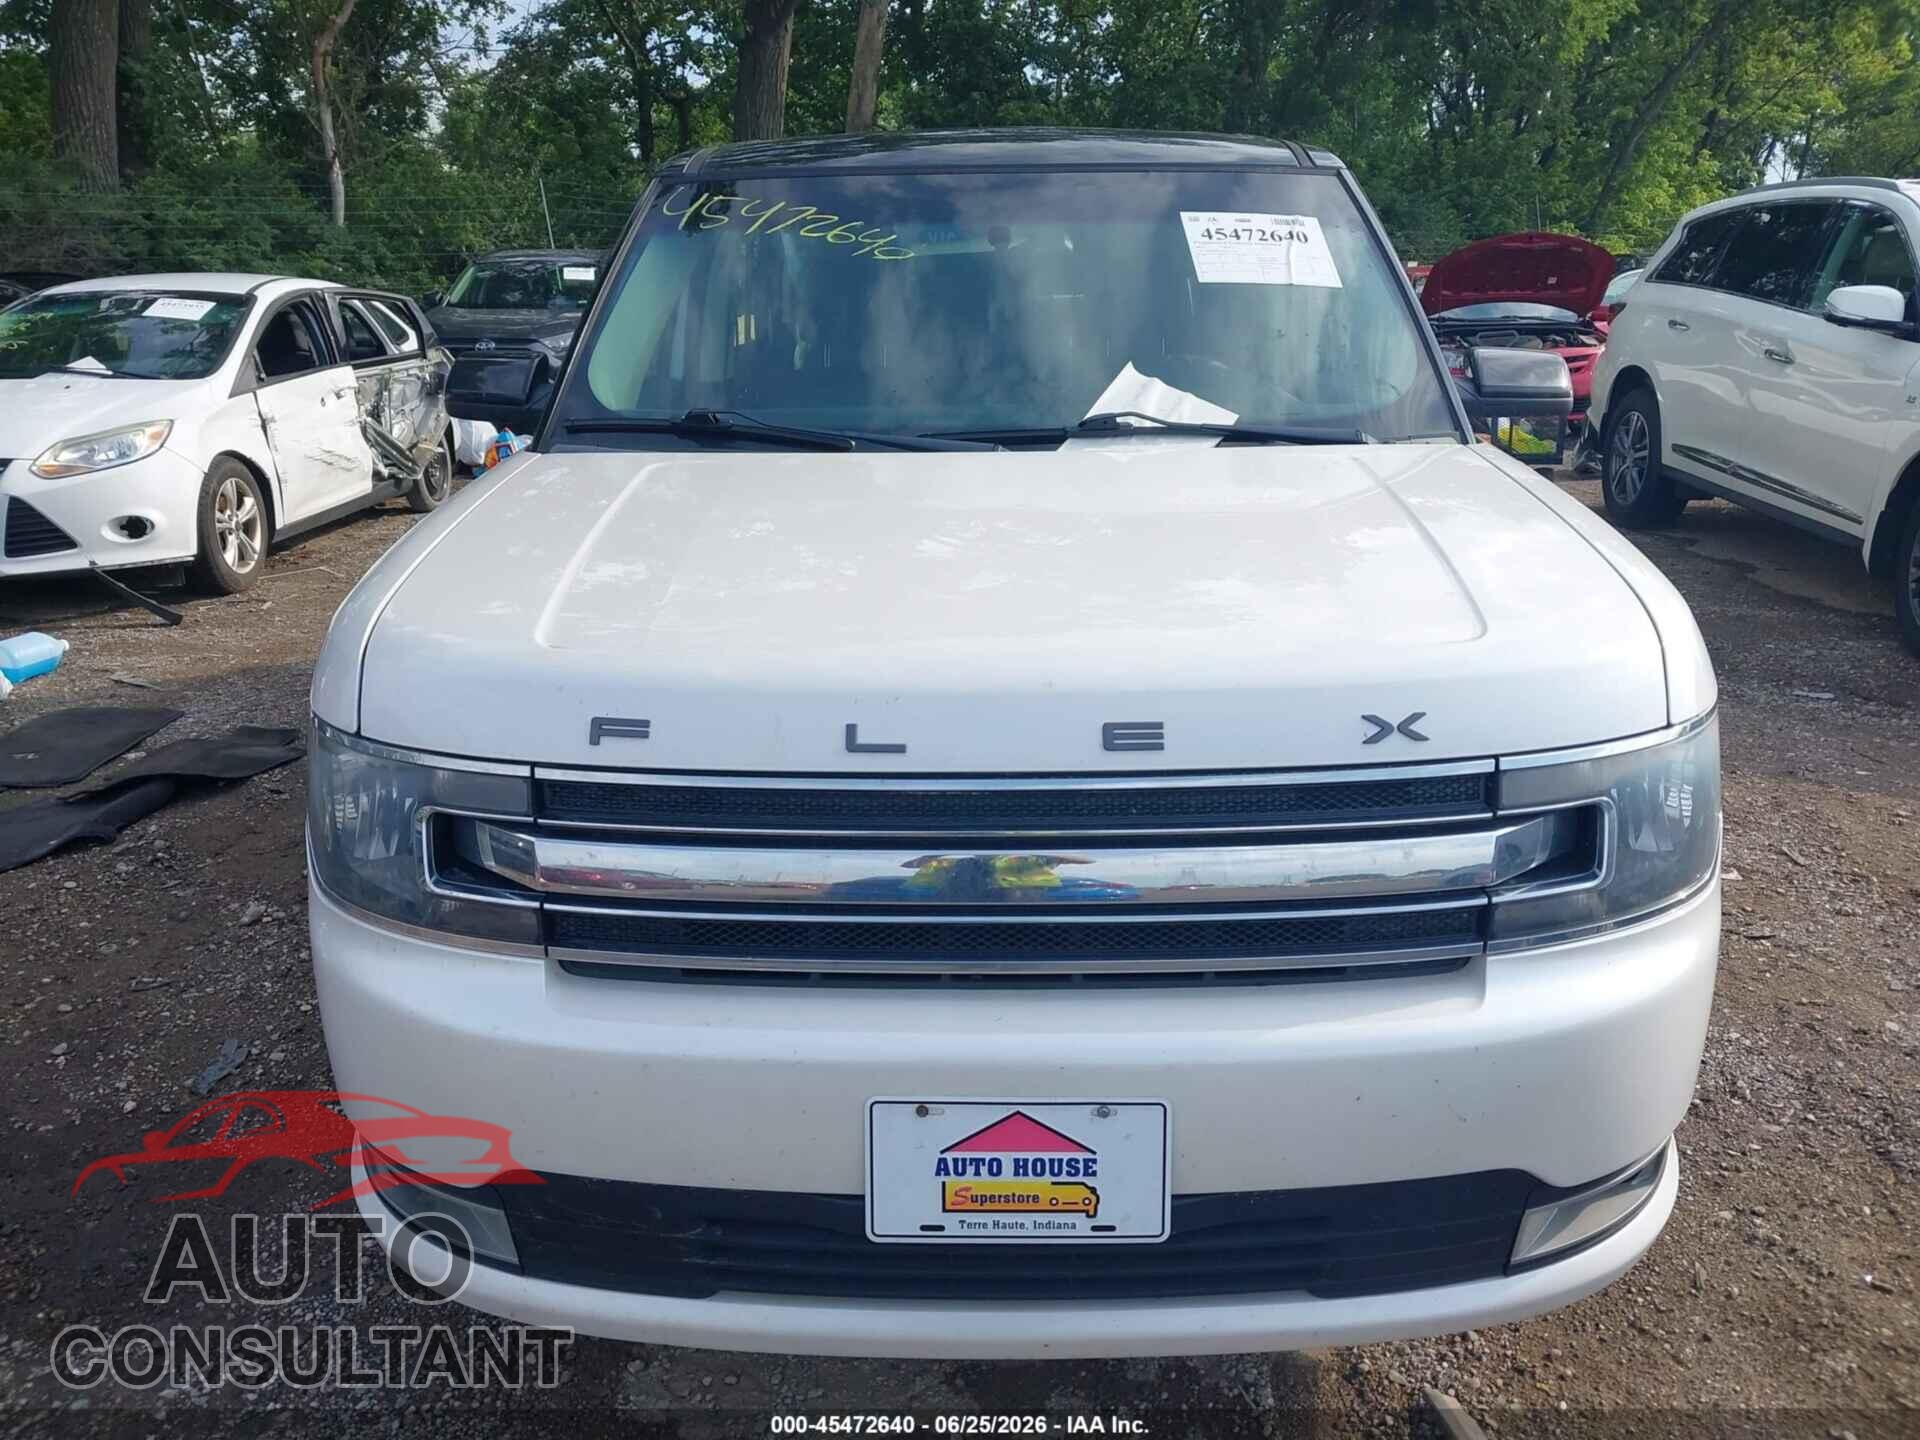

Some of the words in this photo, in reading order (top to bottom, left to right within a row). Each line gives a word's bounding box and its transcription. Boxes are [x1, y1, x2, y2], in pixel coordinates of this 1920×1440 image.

[663, 186, 916, 260] 45472640
[1200, 227, 1309, 243] 45472640
[934, 1156, 1003, 1178] AUTO
[1012, 1156, 1098, 1178] HOUSE
[951, 1186, 1041, 1207] Superstore
[958, 1219, 989, 1231] Terre
[992, 1219, 1030, 1232] Haute,
[1033, 1219, 1077, 1231] Indiana
